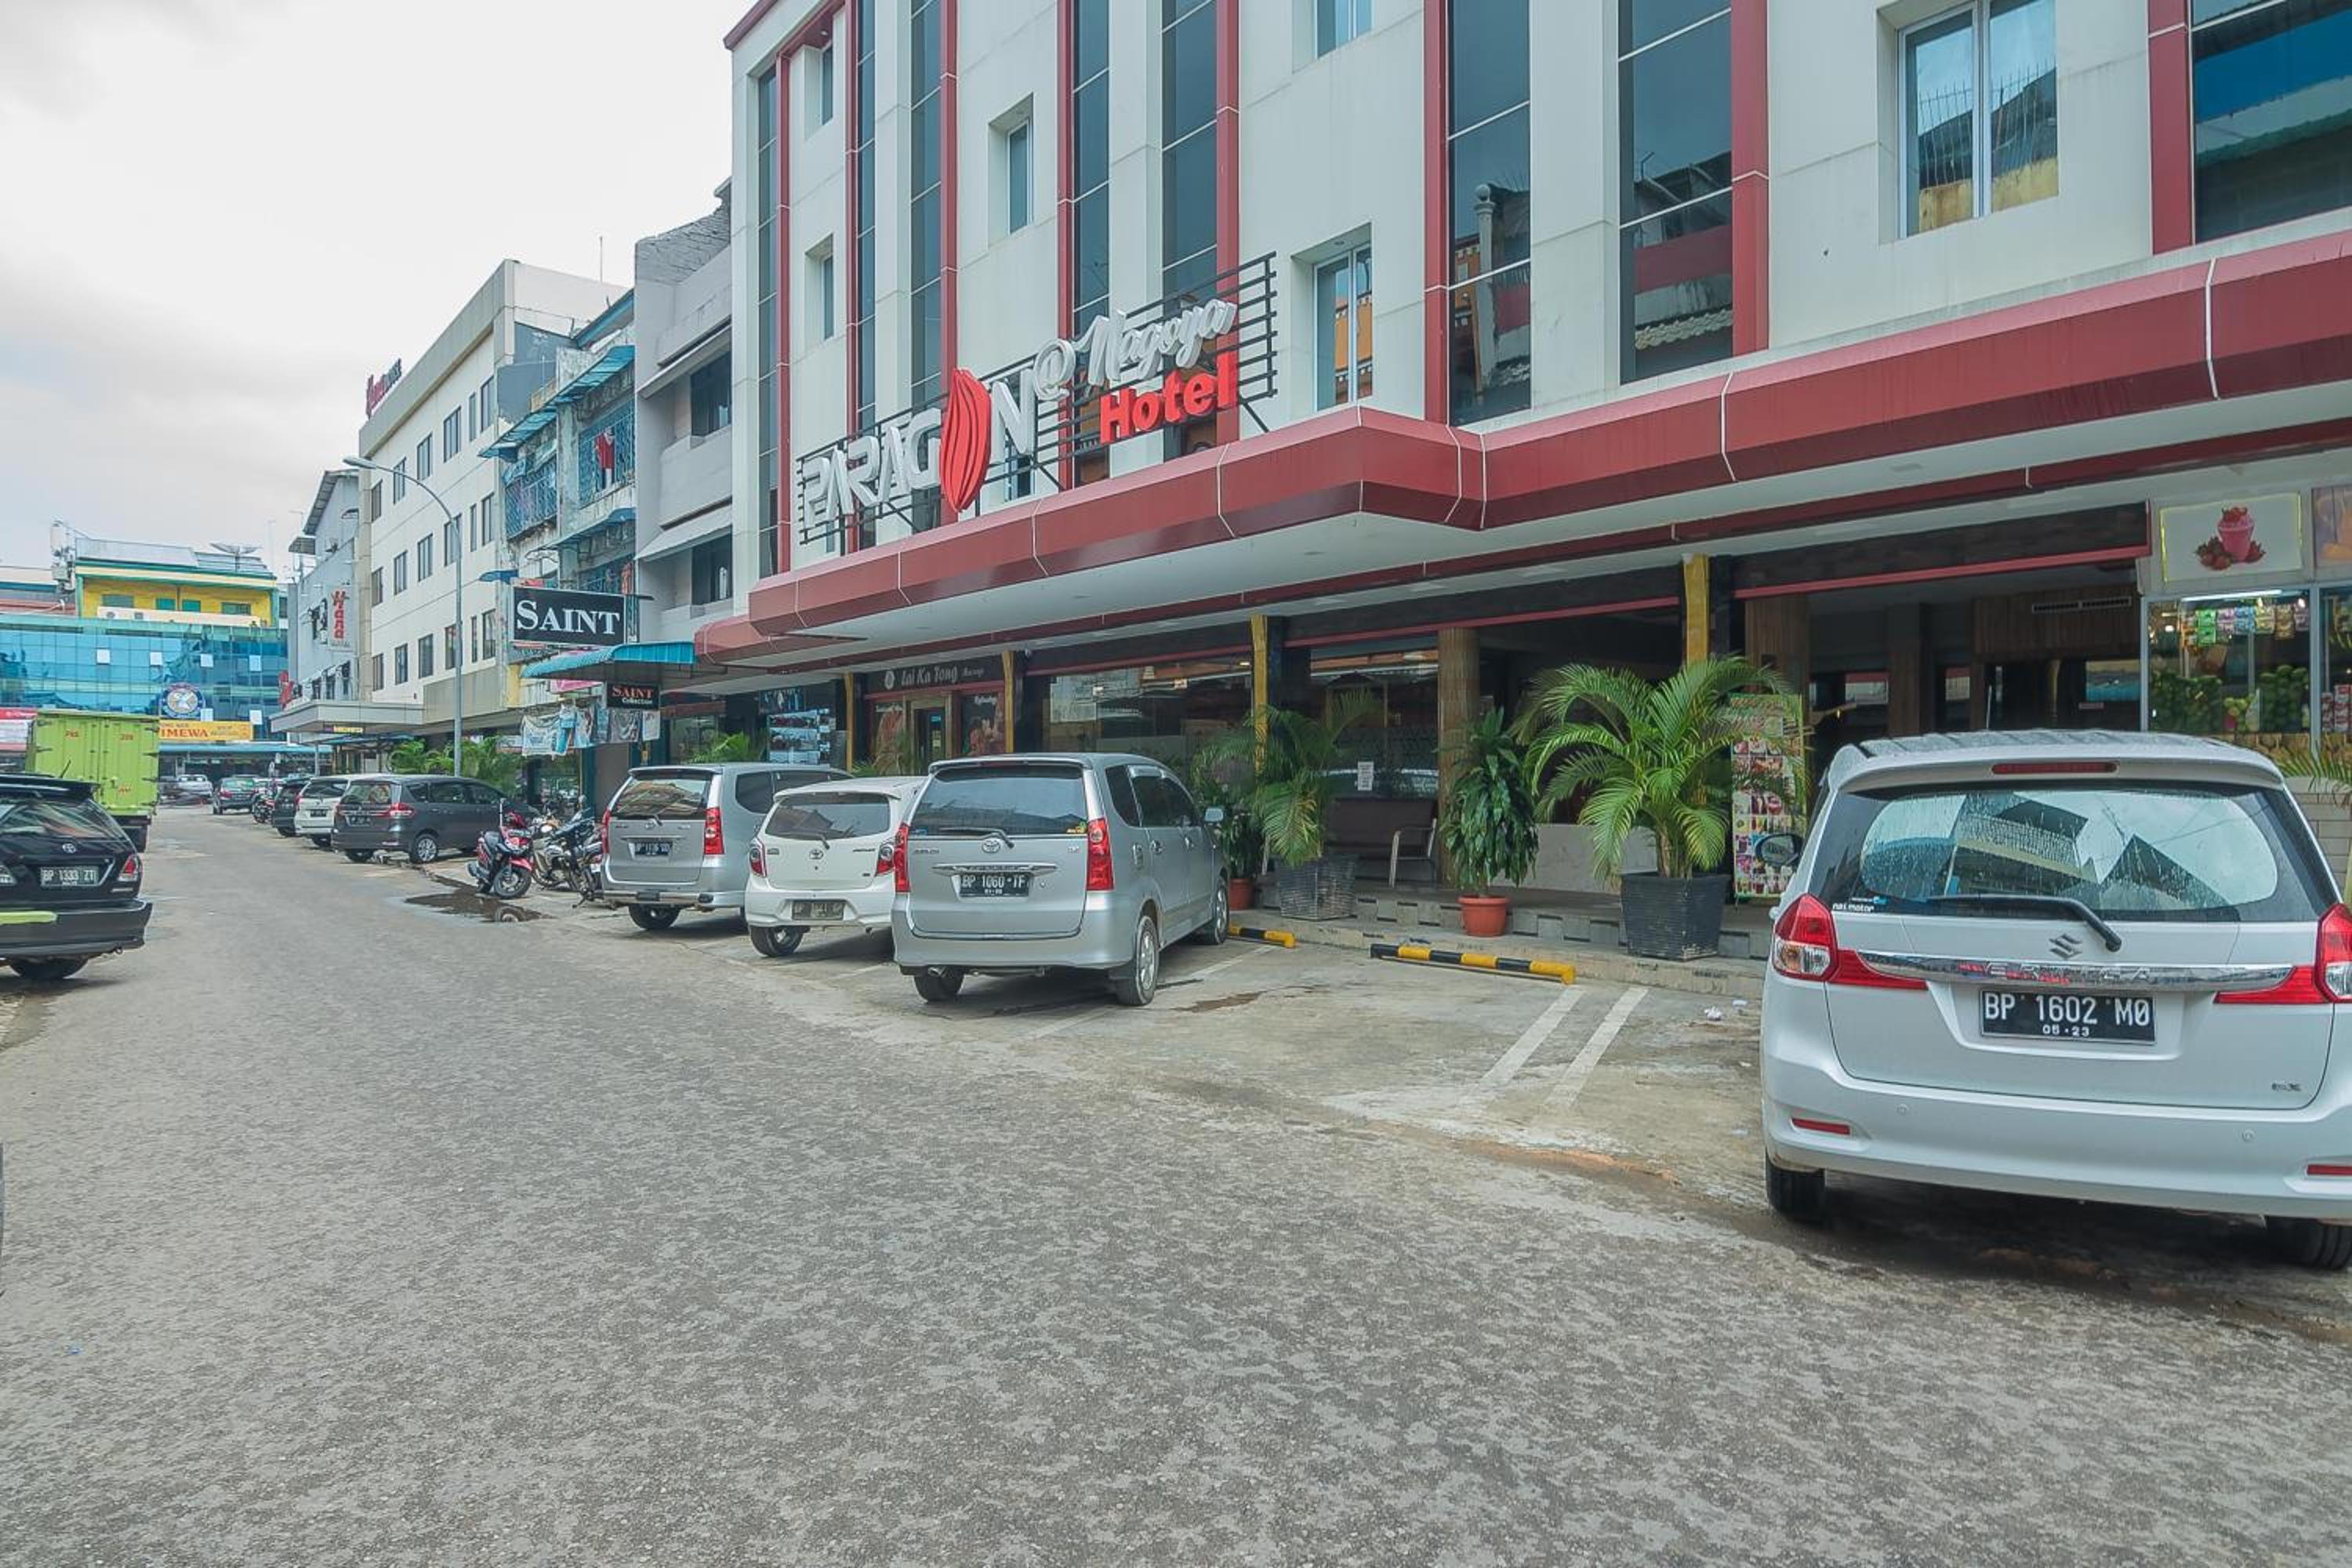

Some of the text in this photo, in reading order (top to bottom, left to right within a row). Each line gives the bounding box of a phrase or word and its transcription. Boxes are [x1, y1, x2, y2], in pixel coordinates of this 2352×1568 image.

[1100, 350, 1238, 446] Hotel
[612, 686, 653, 699] SAINT
[161, 728, 208, 737] IMEWA
[962, 874, 975, 888] BP
[1984, 993, 2016, 1020] BP
[2036, 995, 2097, 1025] 1602
